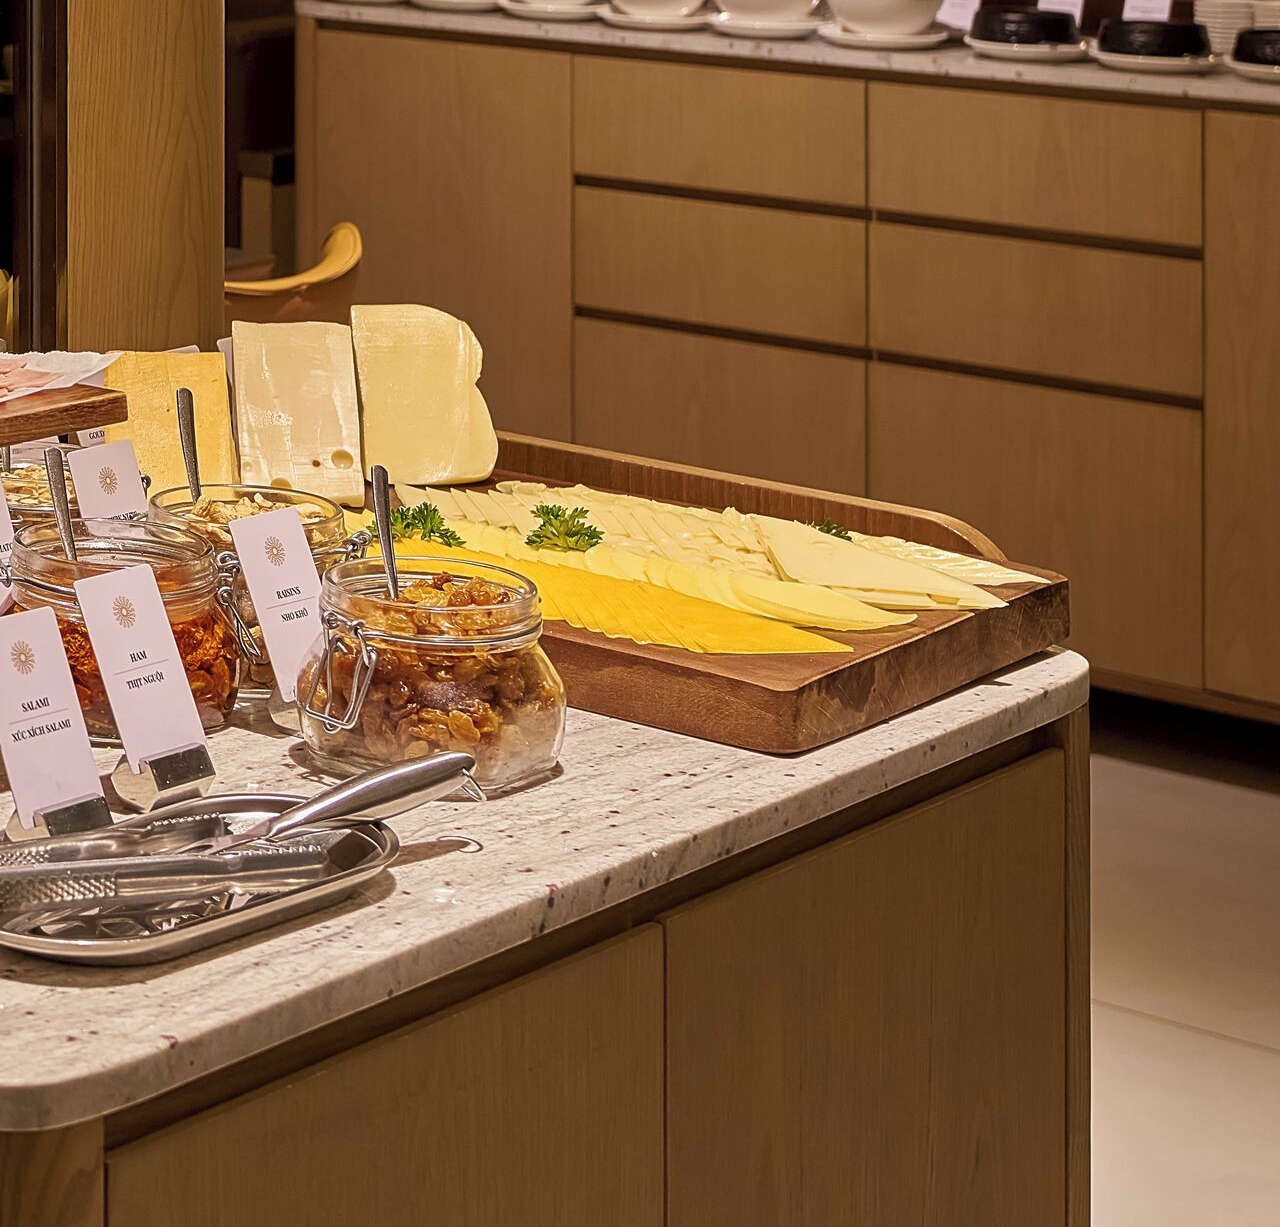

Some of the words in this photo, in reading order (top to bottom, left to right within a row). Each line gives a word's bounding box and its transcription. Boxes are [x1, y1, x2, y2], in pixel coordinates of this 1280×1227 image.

[276, 586, 301, 600] RAISINS
[281, 612, 295, 622] NHO
[295, 607, 309, 619] KHÔ
[130, 650, 147, 662] HAM
[126, 678, 142, 689] THỊT
[143, 671, 164, 684] NGUỘI
[21, 697, 50, 712] SALAMI
[11, 730, 27, 742] XÚC
[27, 725, 46, 738] XÍCH
[46, 719, 71, 733] SALAMI
